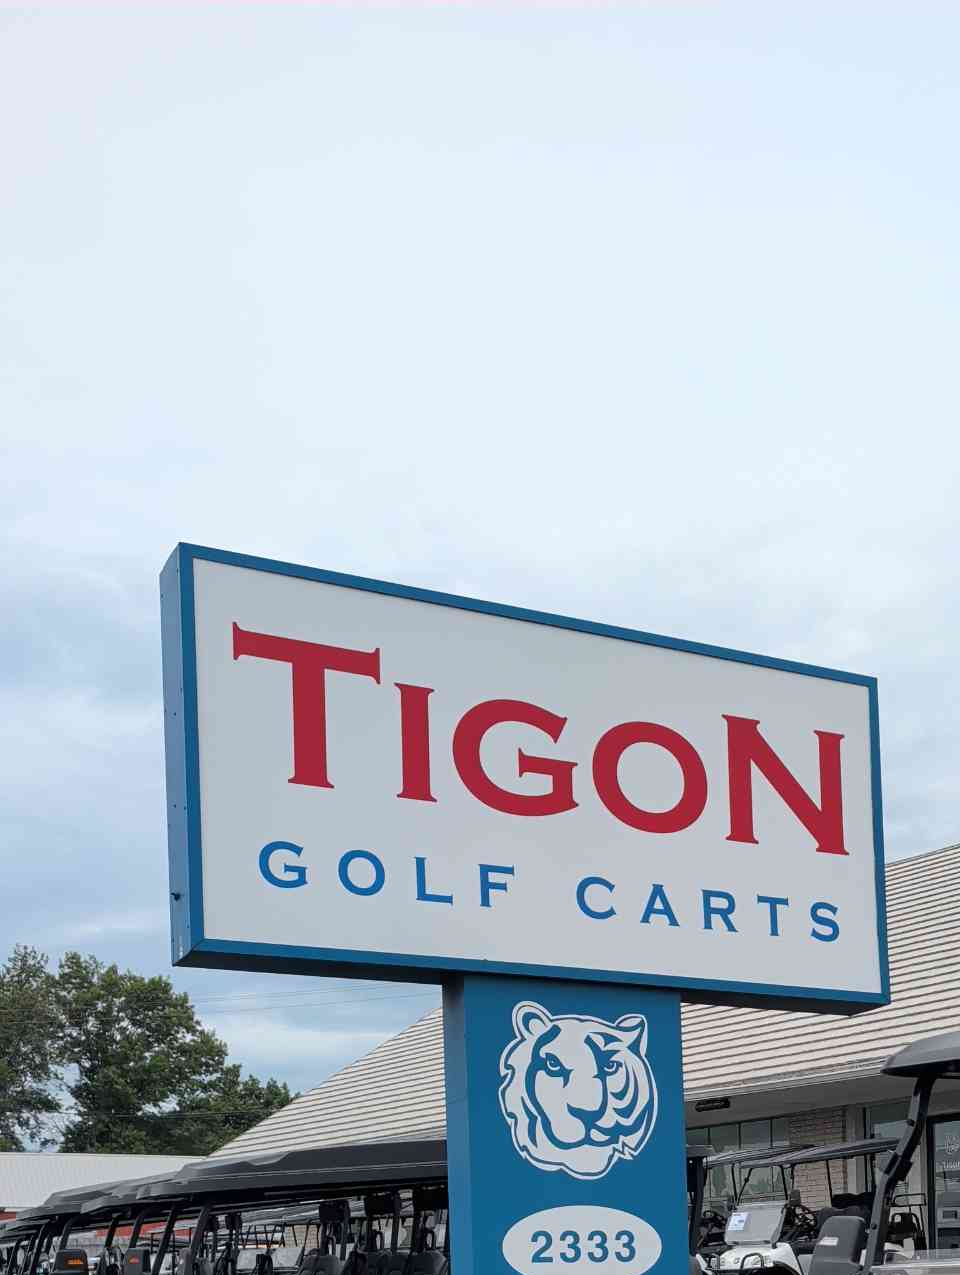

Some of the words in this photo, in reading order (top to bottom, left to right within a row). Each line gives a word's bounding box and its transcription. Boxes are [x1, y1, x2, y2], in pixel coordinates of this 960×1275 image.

[232, 621, 850, 856] TIGON
[258, 841, 515, 908] GOLF
[575, 875, 841, 943] CARTS
[530, 1229, 637, 1264] 2333
